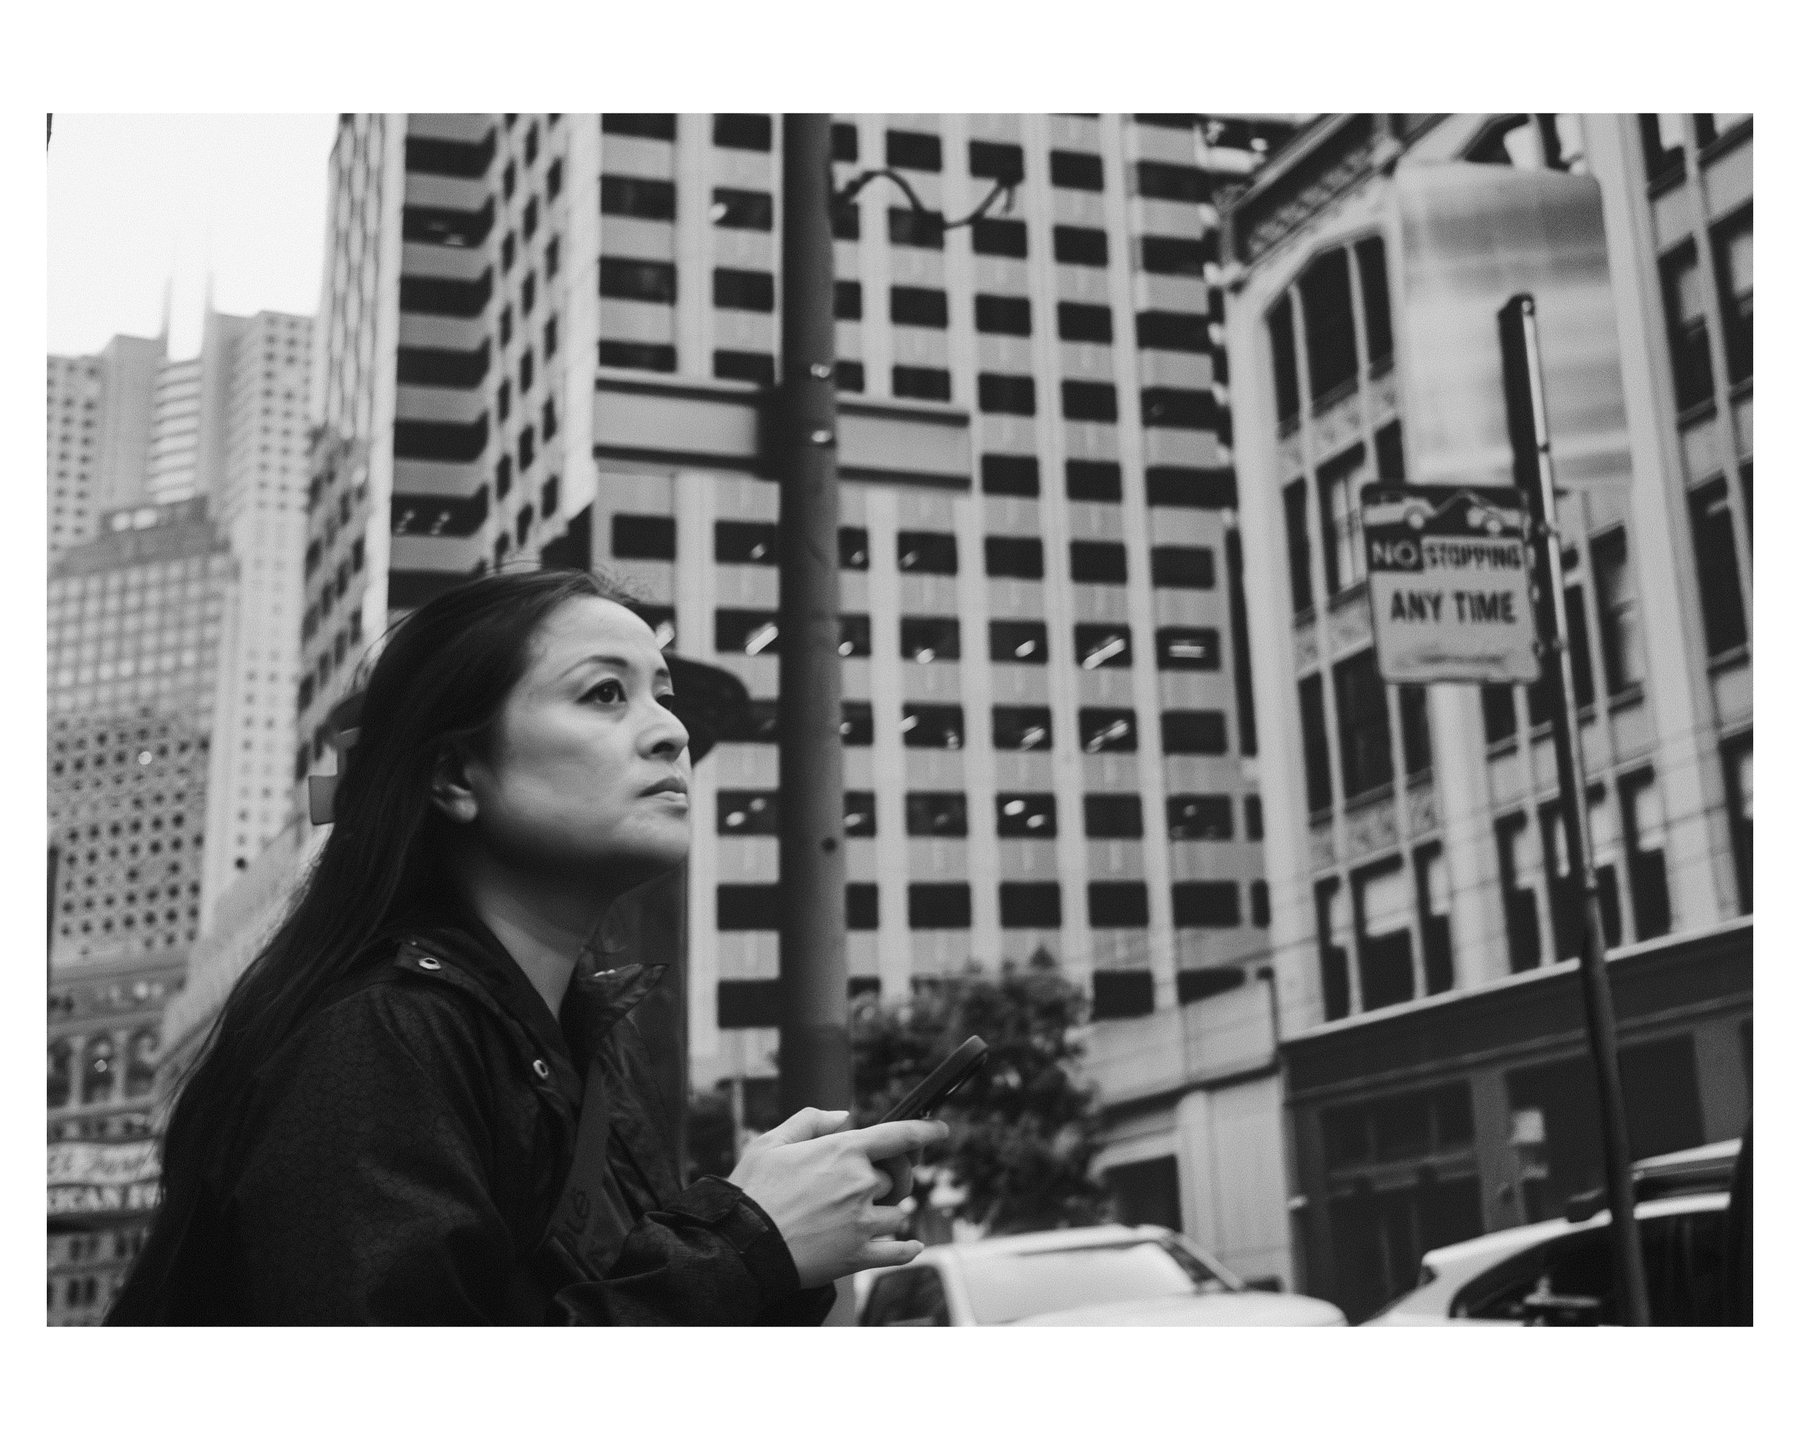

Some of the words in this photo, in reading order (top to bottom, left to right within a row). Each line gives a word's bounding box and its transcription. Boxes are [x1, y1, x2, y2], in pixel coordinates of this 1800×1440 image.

[1372, 540, 1419, 567] NO
[1426, 543, 1523, 571] STOPPING
[1391, 589, 1443, 622] ANY
[1454, 590, 1516, 625] TIME
